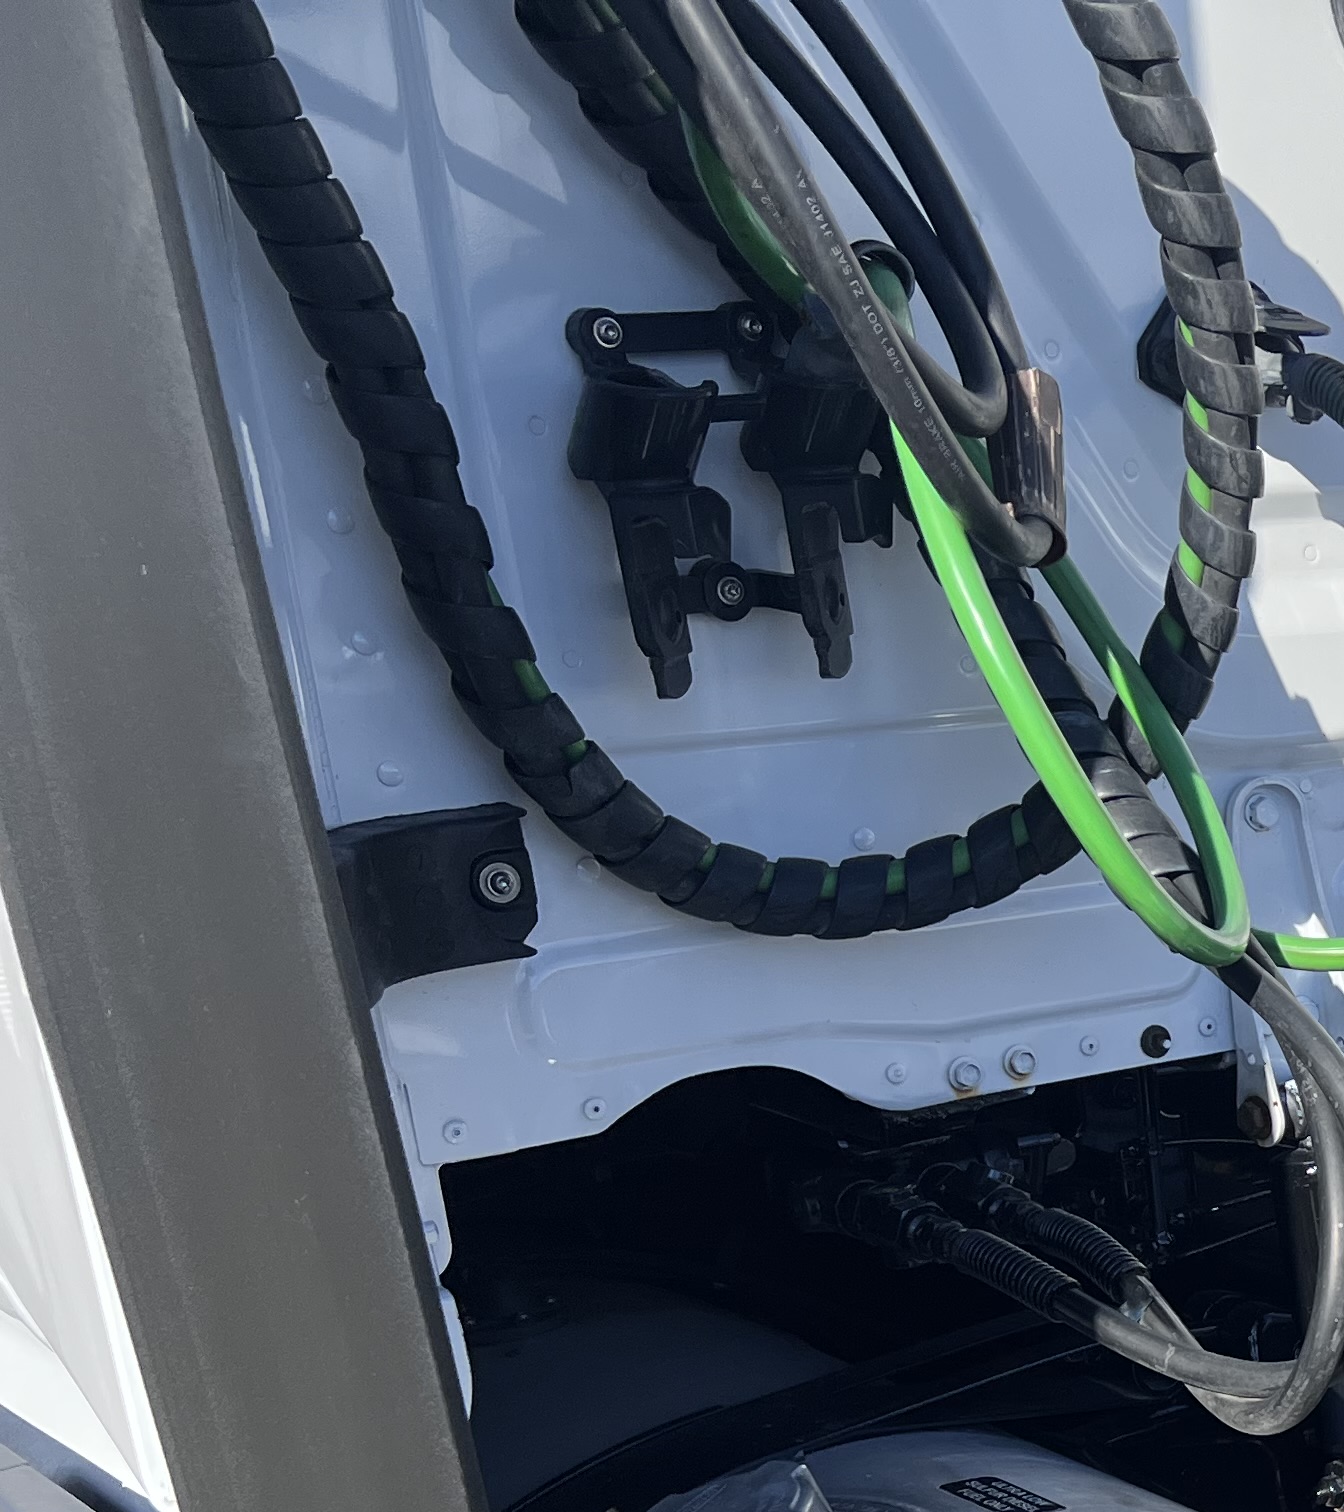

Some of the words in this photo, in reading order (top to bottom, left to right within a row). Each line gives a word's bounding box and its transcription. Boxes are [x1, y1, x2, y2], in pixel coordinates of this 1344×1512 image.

[806, 196, 834, 238] J1402
[831, 244, 853, 276] SAE
[849, 279, 865, 299] ZJ
[861, 303, 884, 335] DOT
[904, 377, 926, 413] 10mm
[924, 416, 951, 459] BRAKE
